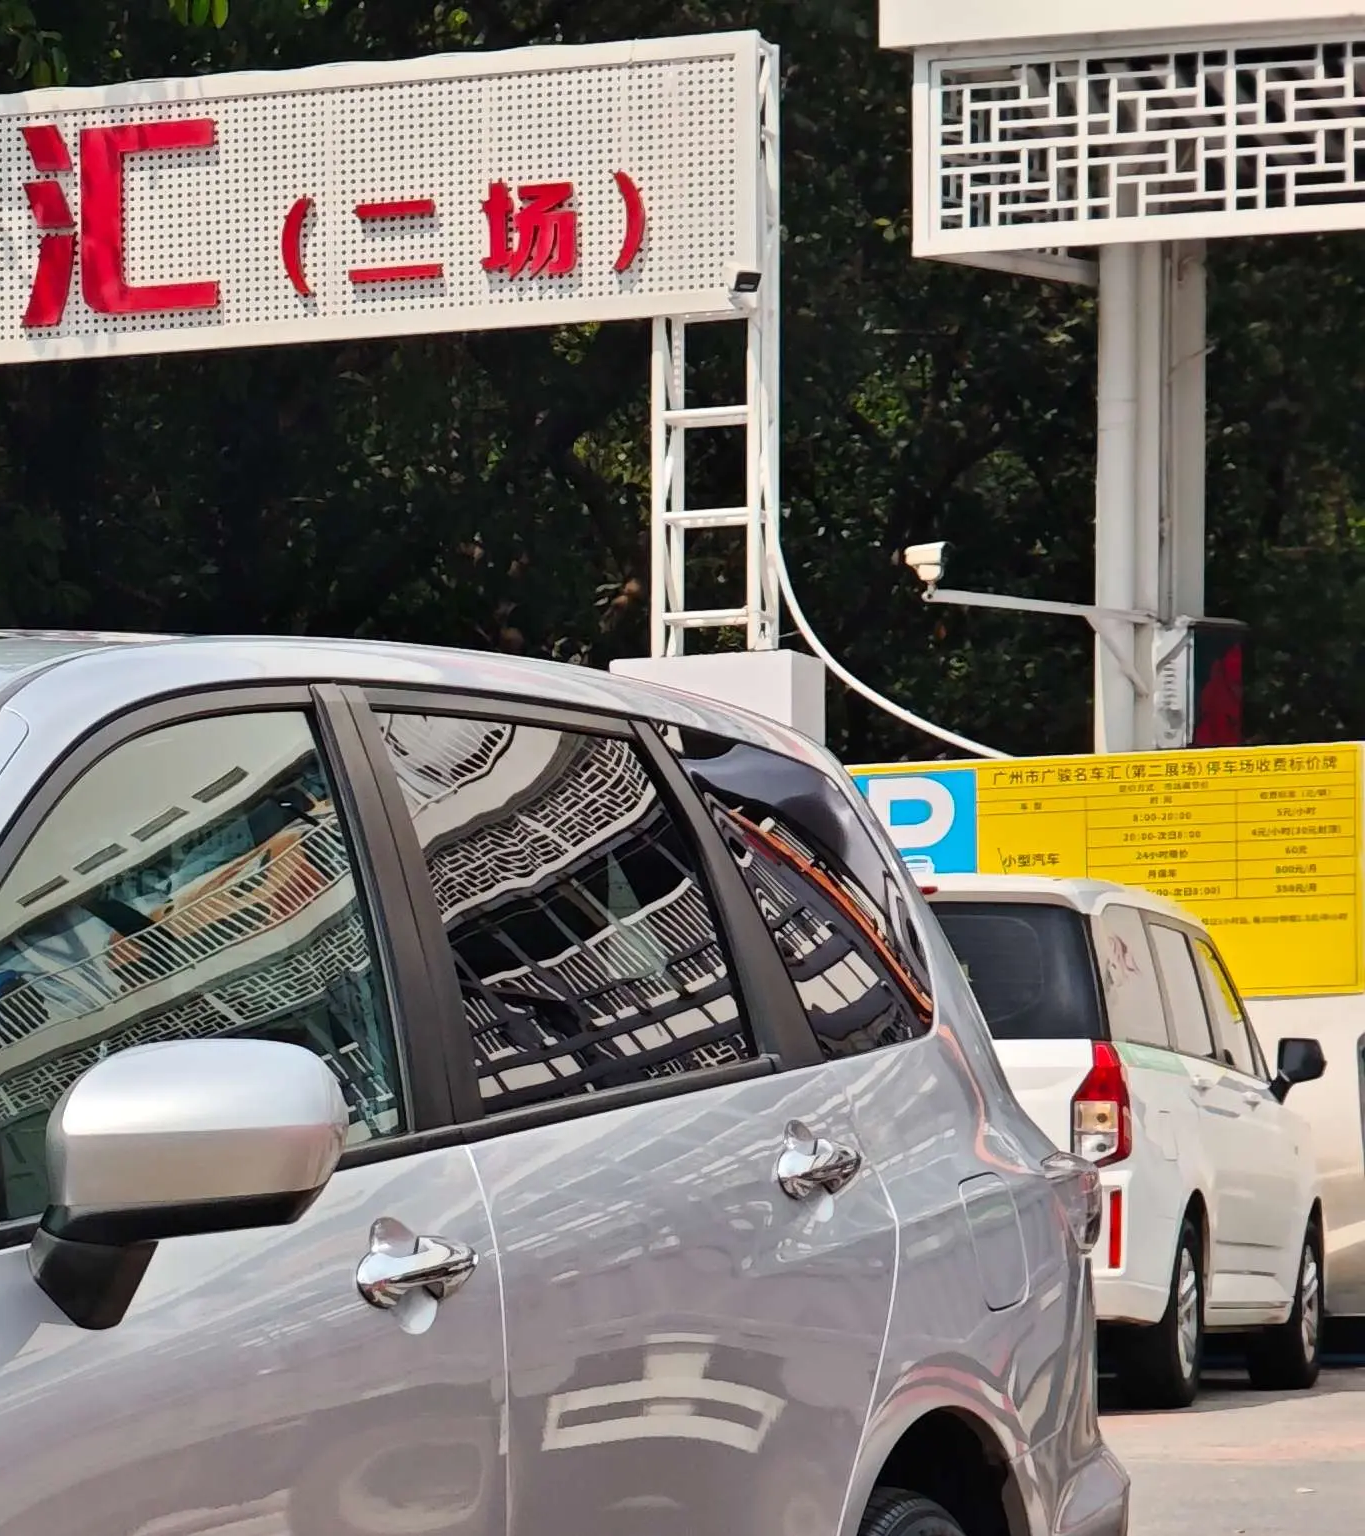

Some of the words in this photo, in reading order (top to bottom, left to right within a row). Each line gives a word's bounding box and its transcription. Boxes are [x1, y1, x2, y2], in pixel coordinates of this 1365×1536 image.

[868, 777, 956, 849] P
[1004, 852, 1061, 868] 小型汽车
